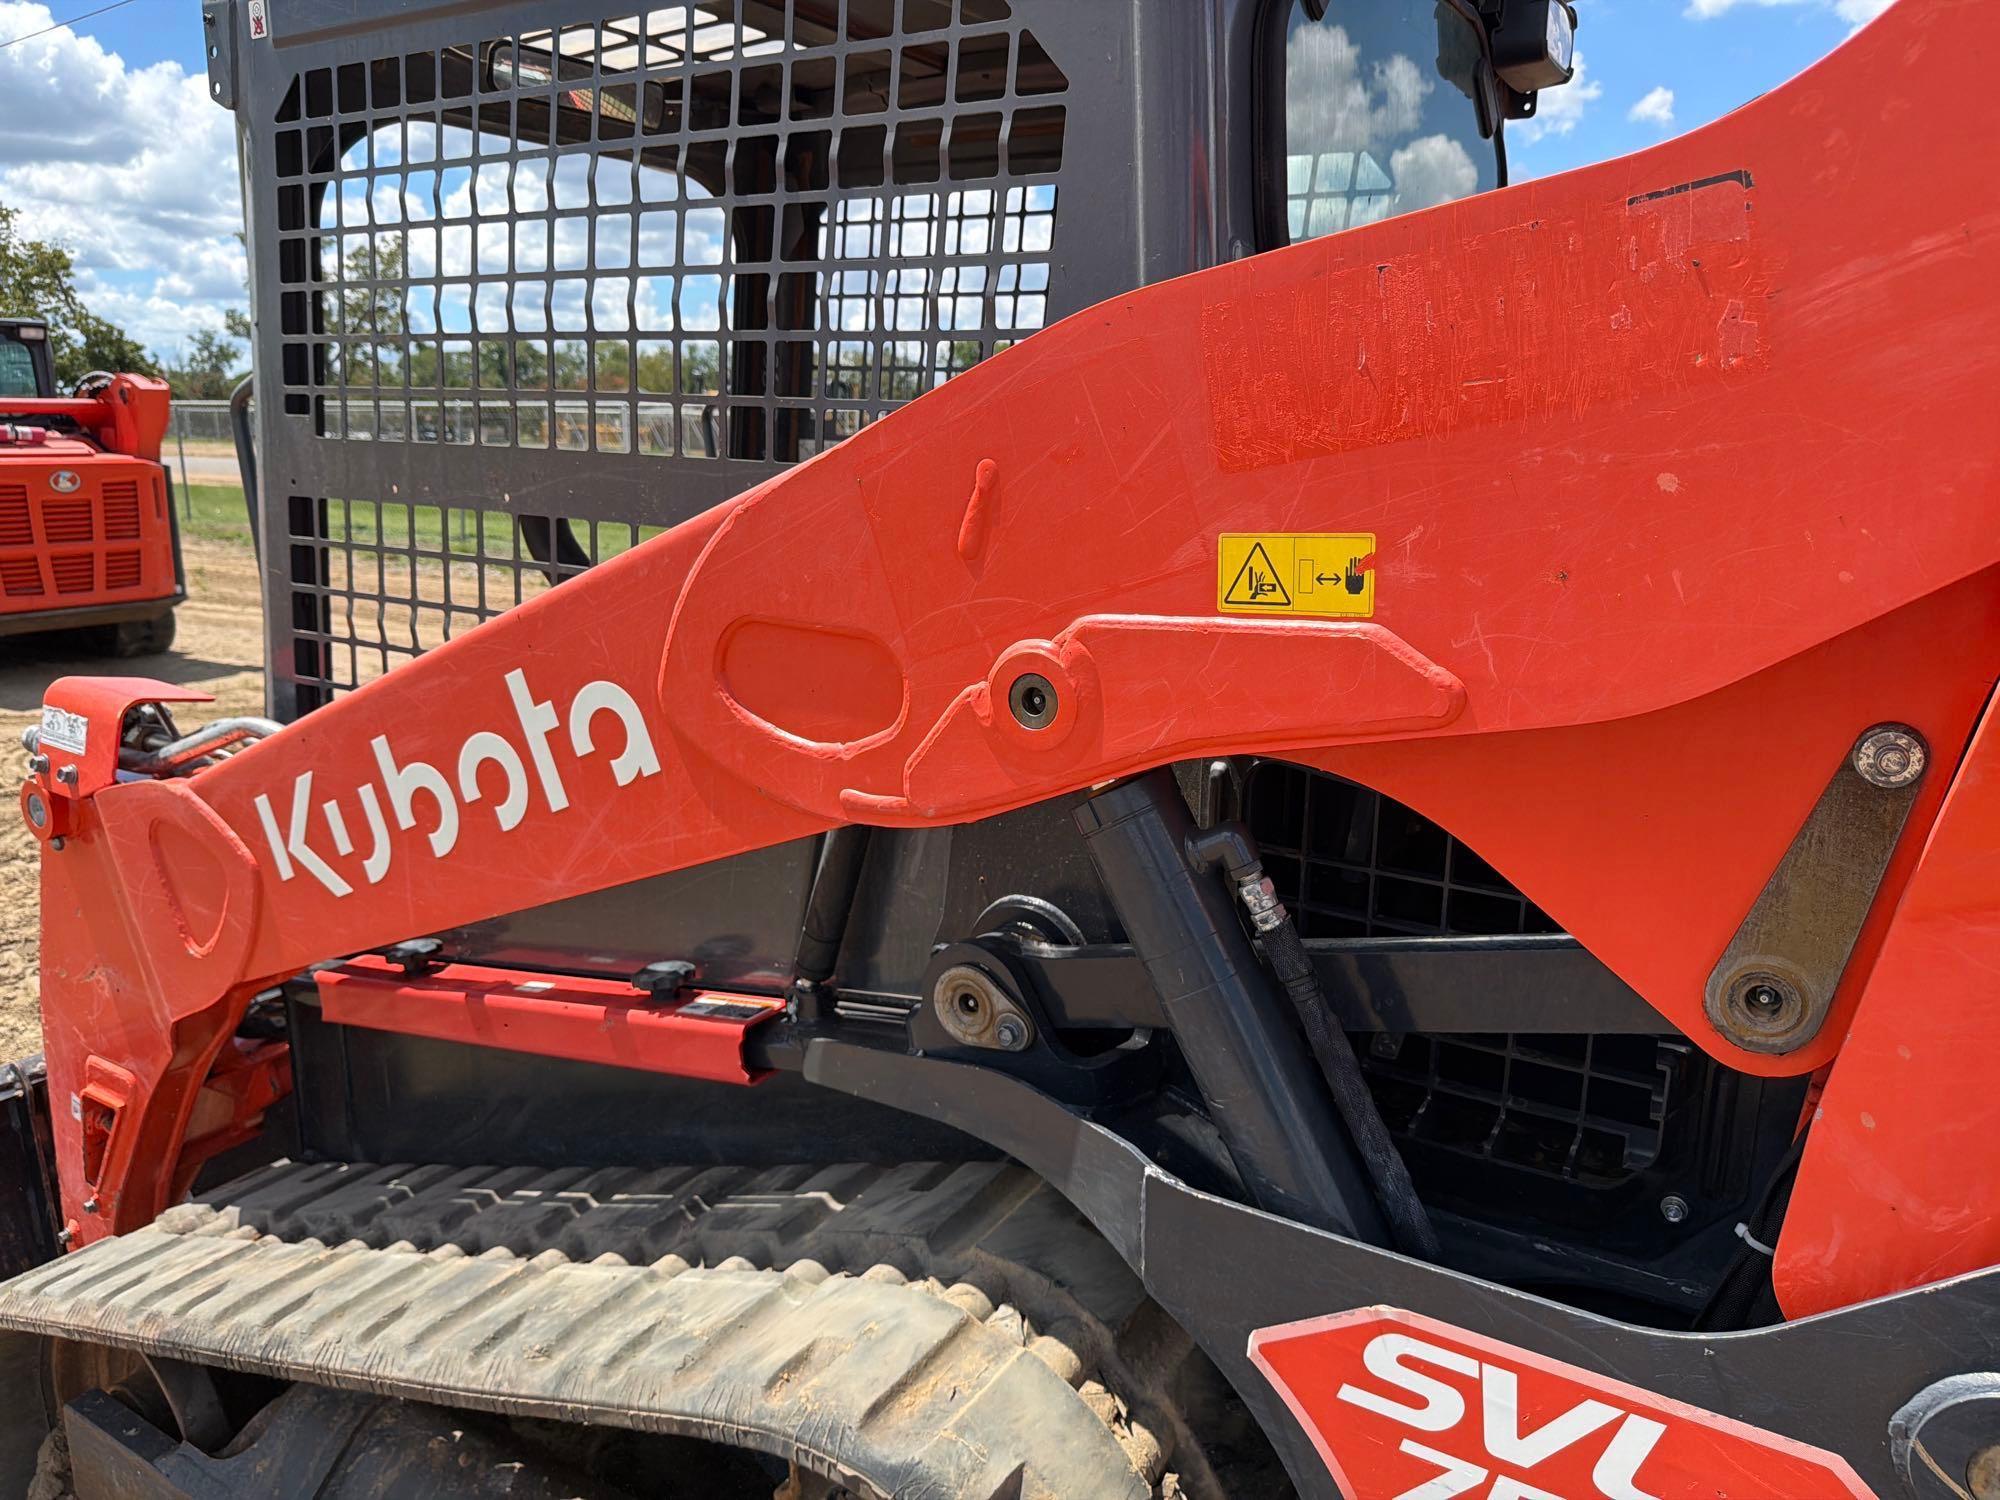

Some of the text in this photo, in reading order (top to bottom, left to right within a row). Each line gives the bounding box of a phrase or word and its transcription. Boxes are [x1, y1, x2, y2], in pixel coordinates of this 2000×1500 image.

[254, 668, 661, 897] Kubota
[1336, 1333, 1667, 1500] SVL
[1391, 1438, 1567, 1500] 7
